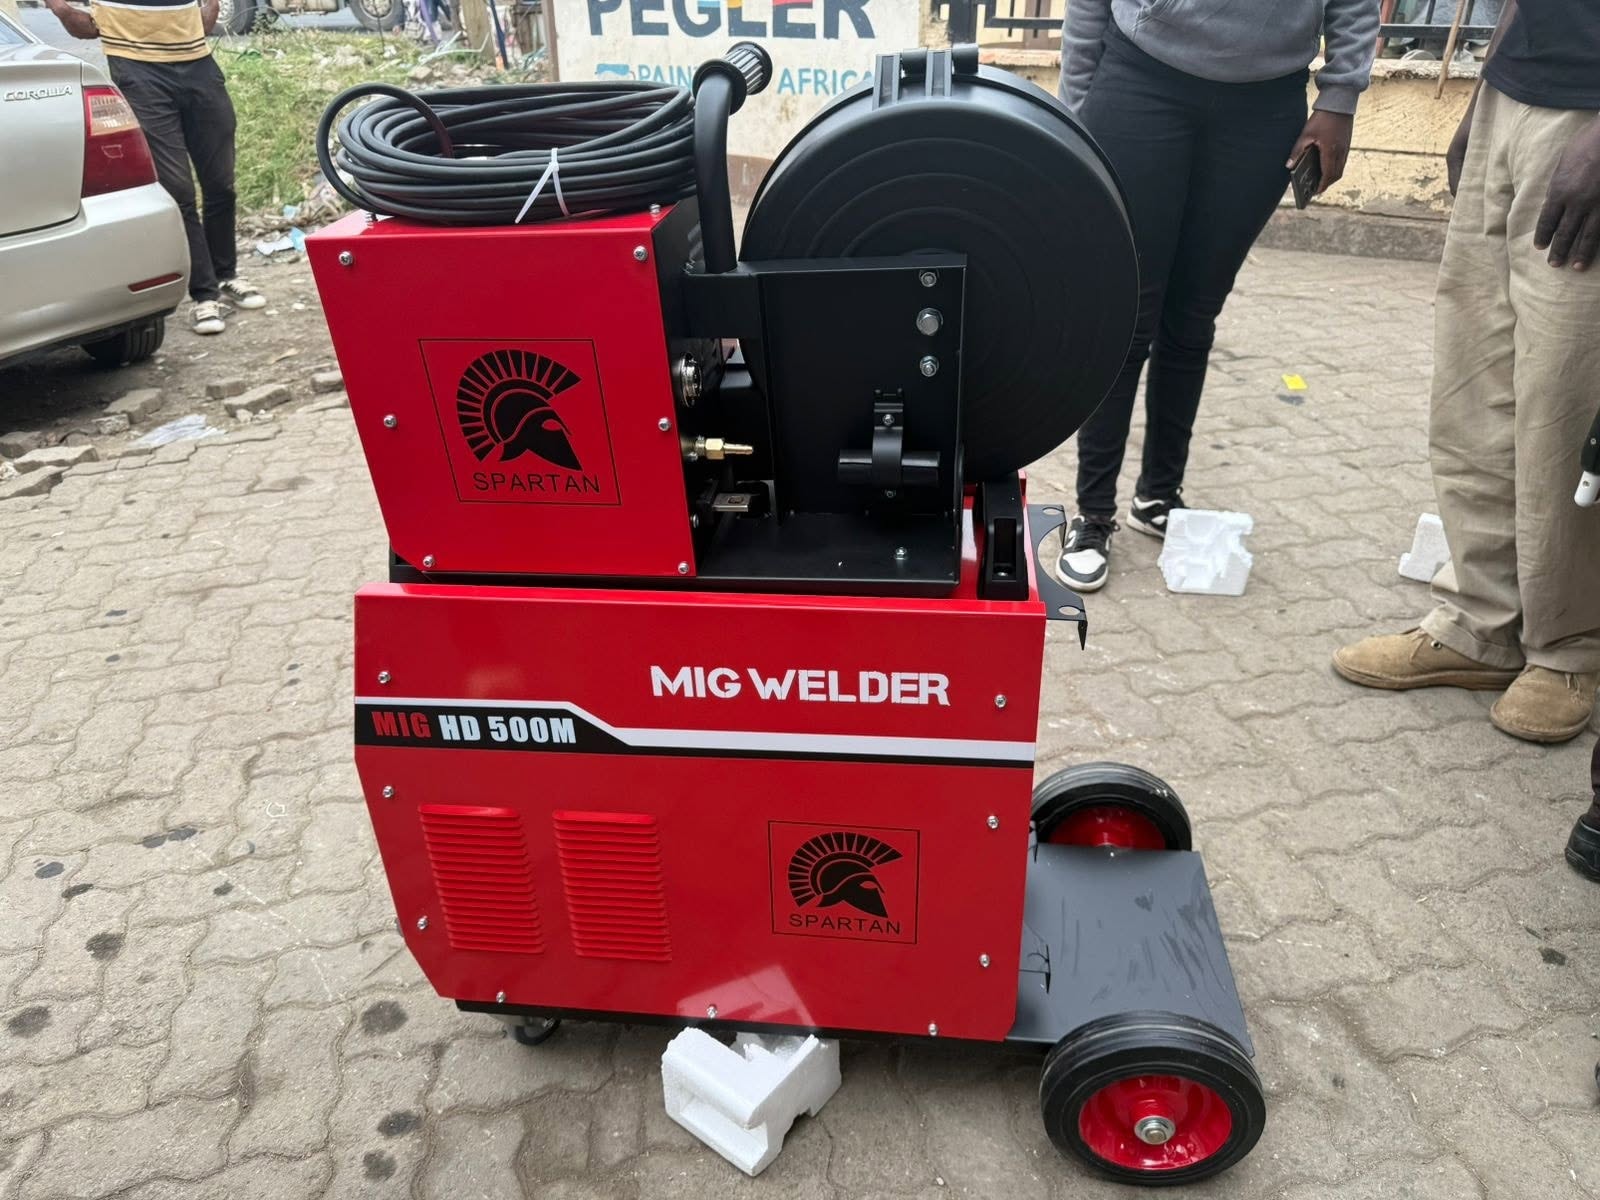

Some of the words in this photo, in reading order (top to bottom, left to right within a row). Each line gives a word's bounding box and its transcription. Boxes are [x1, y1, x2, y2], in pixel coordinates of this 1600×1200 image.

[587, 0, 875, 39] PEGLER
[3, 84, 73, 102] COROLLA
[638, 64, 697, 91] PAIN
[777, 67, 873, 95] AFRIC
[472, 472, 601, 493] SPARTAN
[650, 665, 742, 698] MIG
[747, 667, 951, 706] WELDER
[371, 711, 432, 738] MIG
[438, 714, 481, 741] HD
[487, 716, 577, 744] 500M
[789, 913, 901, 935] SPARTAN
